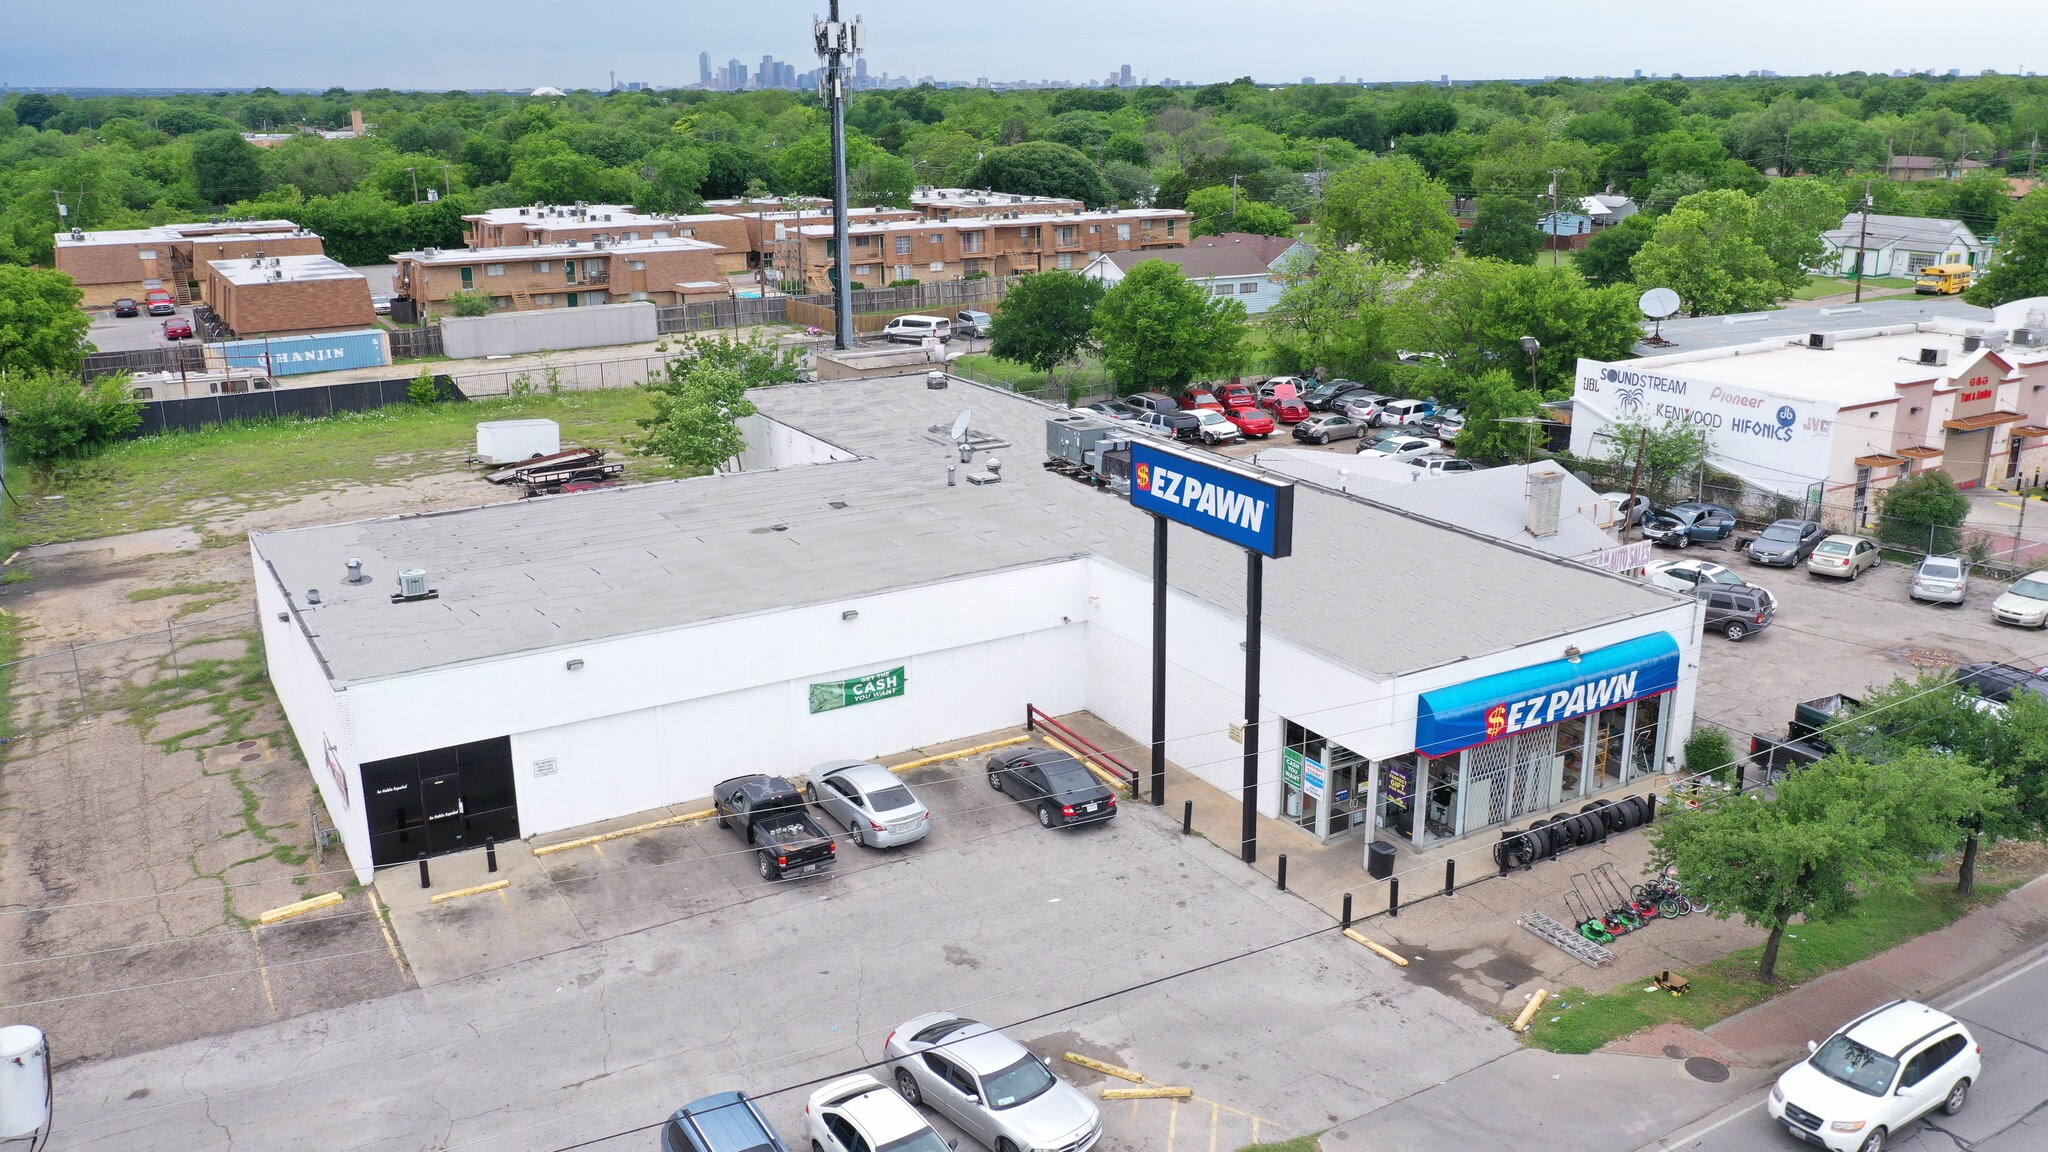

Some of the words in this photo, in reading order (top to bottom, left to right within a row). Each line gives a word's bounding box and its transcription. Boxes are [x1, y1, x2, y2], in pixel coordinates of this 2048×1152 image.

[276, 348, 344, 364] HANJIN
[1709, 386, 1765, 409] Pioneer
[1656, 403, 1723, 428] KENWOOD
[1731, 417, 1794, 443] HIFONICS
[852, 675, 897, 695] CASH
[854, 694, 871, 702] YOU
[873, 688, 896, 697] WANT
[1286, 759, 1300, 769] CASH
[1287, 765, 1298, 775] YOU
[1285, 771, 1300, 781] WANT
[1389, 774, 1407, 786] PERFECT
[1390, 780, 1406, 791] GIFT
